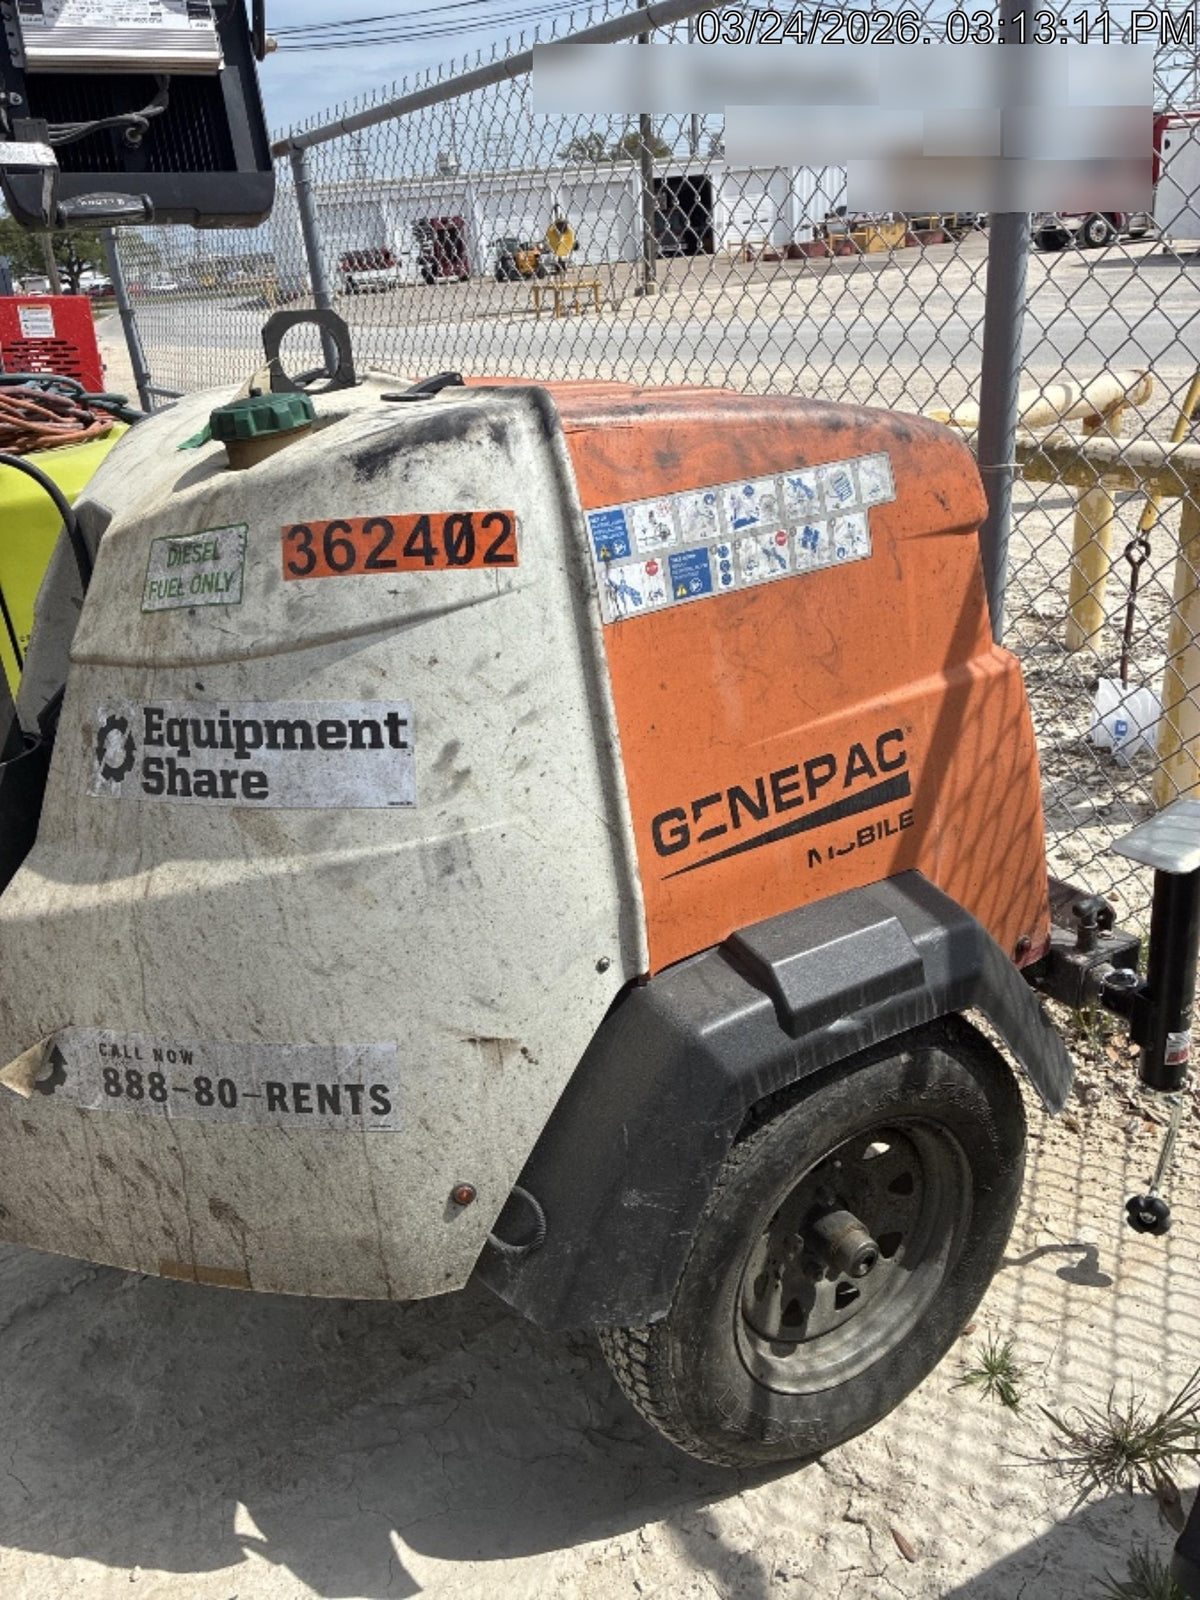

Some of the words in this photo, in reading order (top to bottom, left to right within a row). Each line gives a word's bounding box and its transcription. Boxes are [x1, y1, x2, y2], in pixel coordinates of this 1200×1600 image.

[166, 537, 221, 568] DIESEL
[287, 512, 515, 576] 362402
[148, 578, 185, 600] FUEL
[189, 571, 235, 595] ONLY
[142, 707, 408, 760] Equipment
[141, 756, 270, 800] Share
[99, 1043, 144, 1061] CALL
[153, 1048, 194, 1065] NOW
[102, 1067, 393, 1116] 888-80-RENTS
